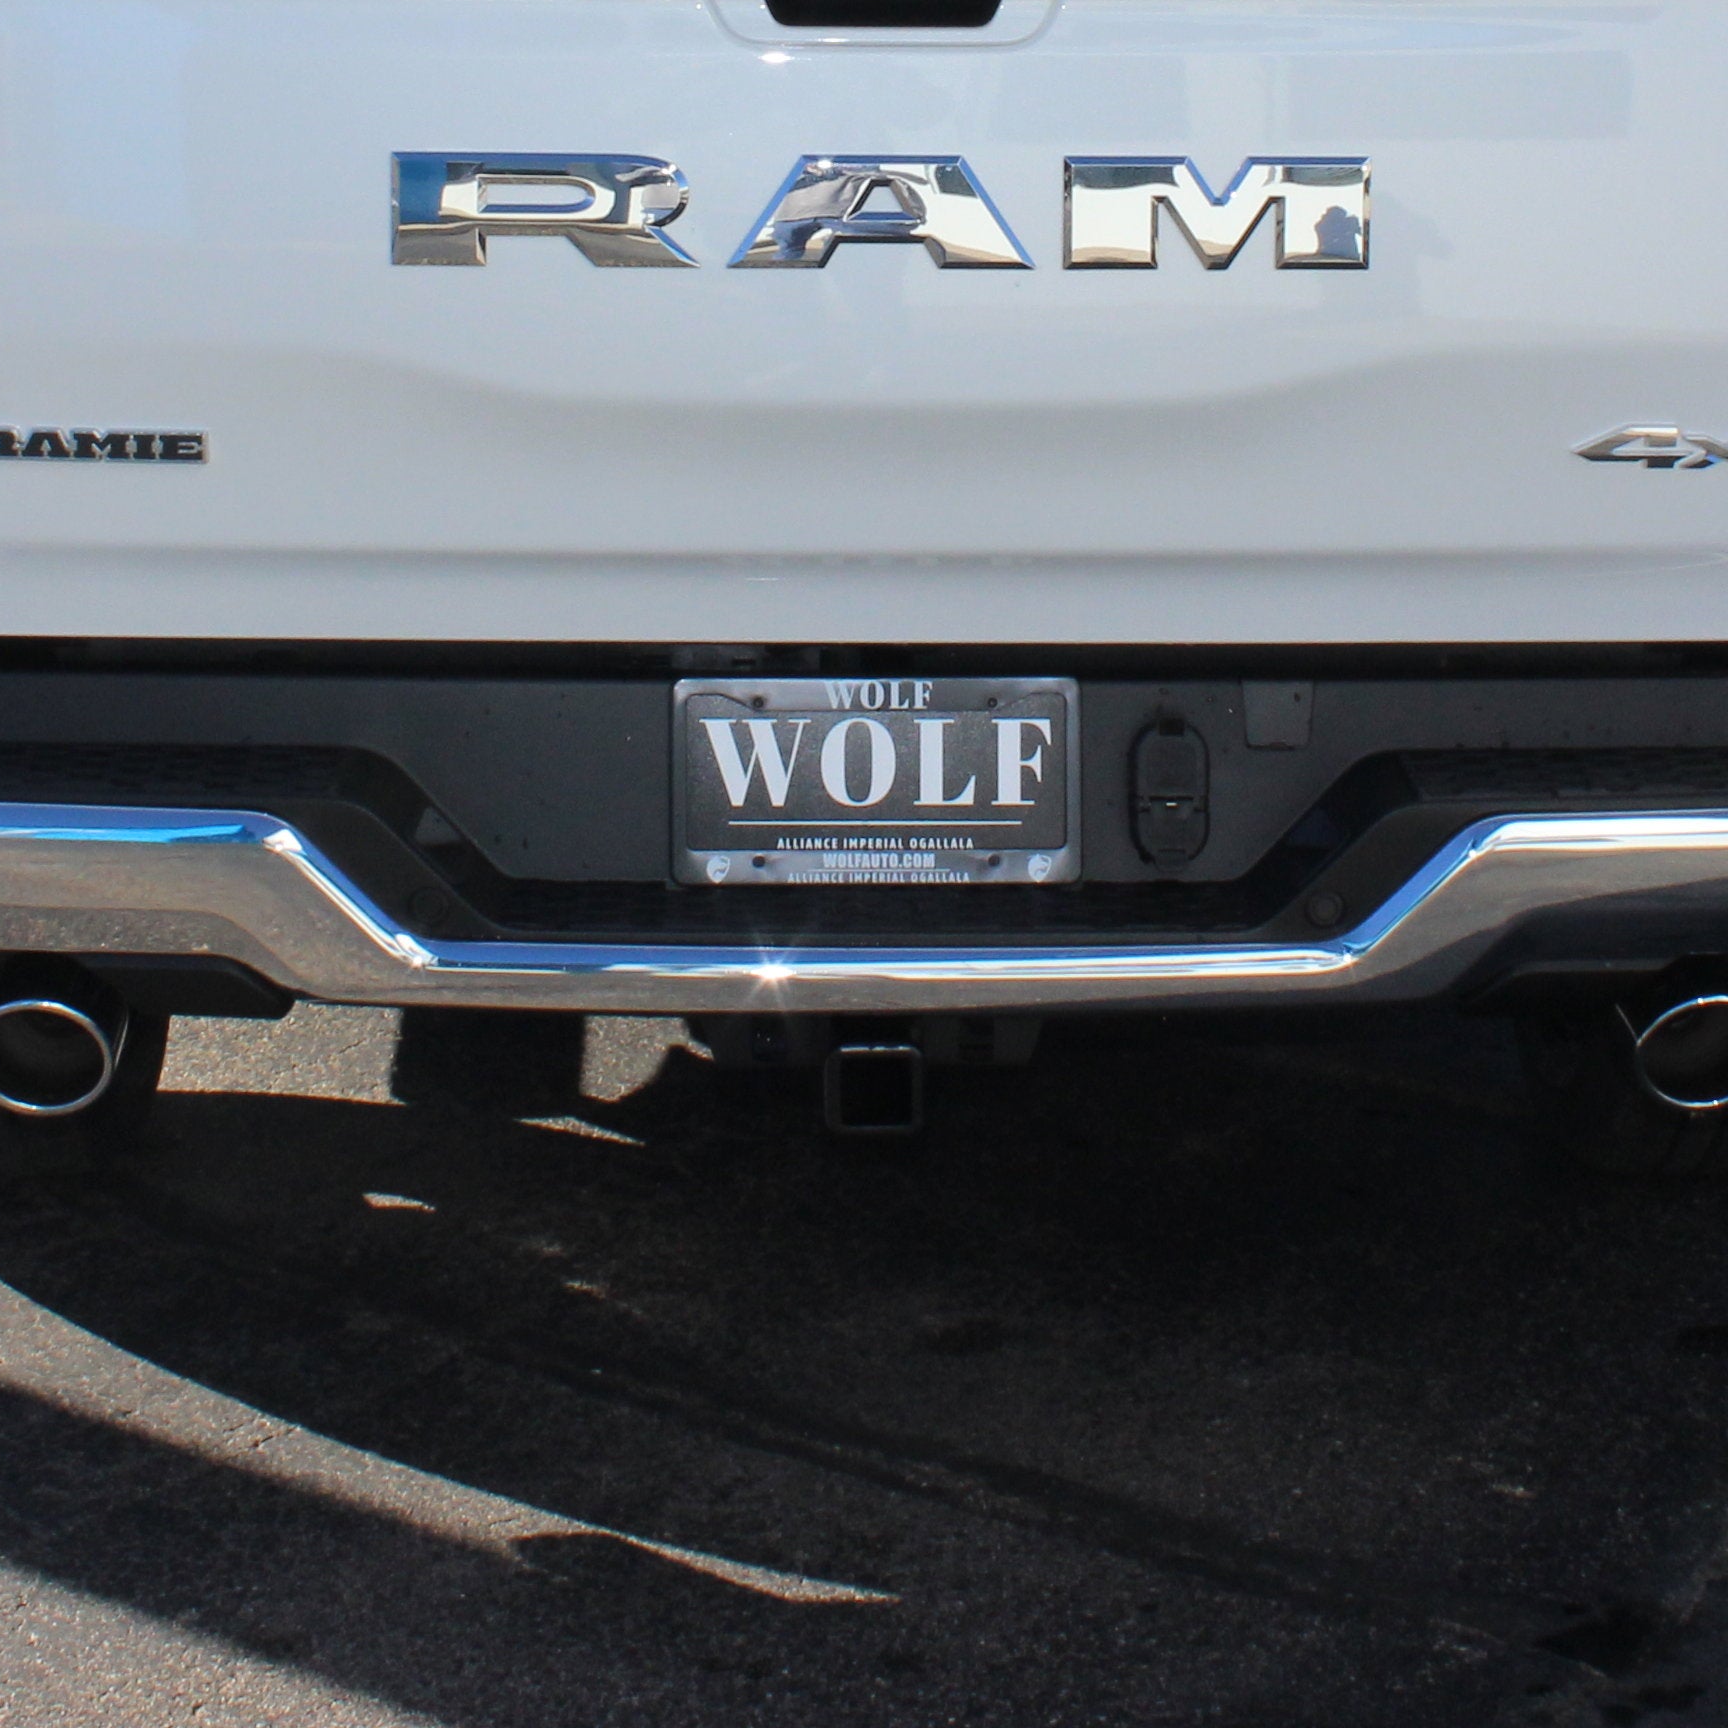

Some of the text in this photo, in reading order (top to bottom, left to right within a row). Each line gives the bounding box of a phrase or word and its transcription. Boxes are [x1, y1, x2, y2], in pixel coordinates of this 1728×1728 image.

[391, 151, 1371, 271] RAM
[824, 680, 934, 710] WOLF
[698, 717, 1053, 808] WOLF
[776, 837, 974, 850] ALLIANCE IMPERIAL OGALLALA
[822, 852, 936, 869] WOLFAUTO.COM
[787, 872, 971, 884] ALLIANCE IMPERIAL OGALLALA
